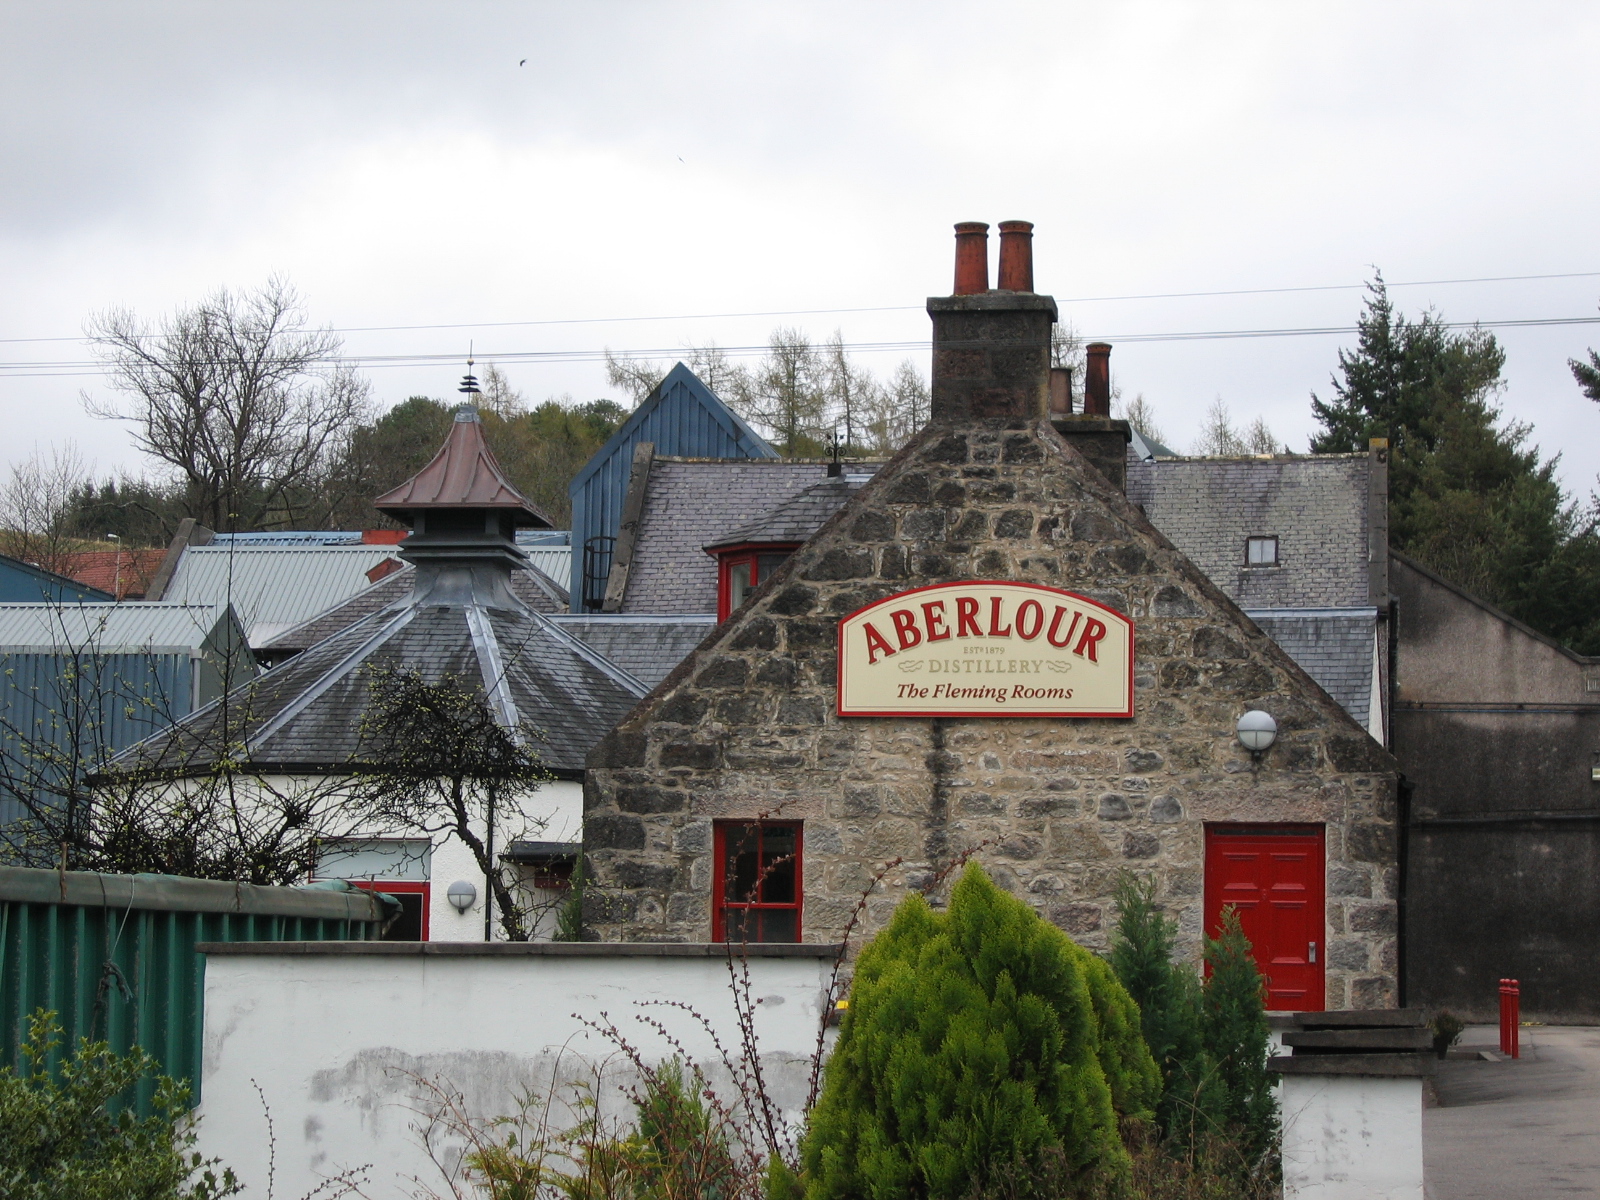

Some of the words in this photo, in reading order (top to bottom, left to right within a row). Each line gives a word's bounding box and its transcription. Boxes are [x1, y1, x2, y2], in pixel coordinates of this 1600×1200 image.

[862, 596, 1107, 665] ABERLOUR
[985, 646, 1006, 655] 1879
[928, 659, 1044, 673] DISTILLERY
[897, 683, 929, 699] The
[932, 683, 1008, 703] Fleming
[1011, 684, 1074, 699] Rooms
